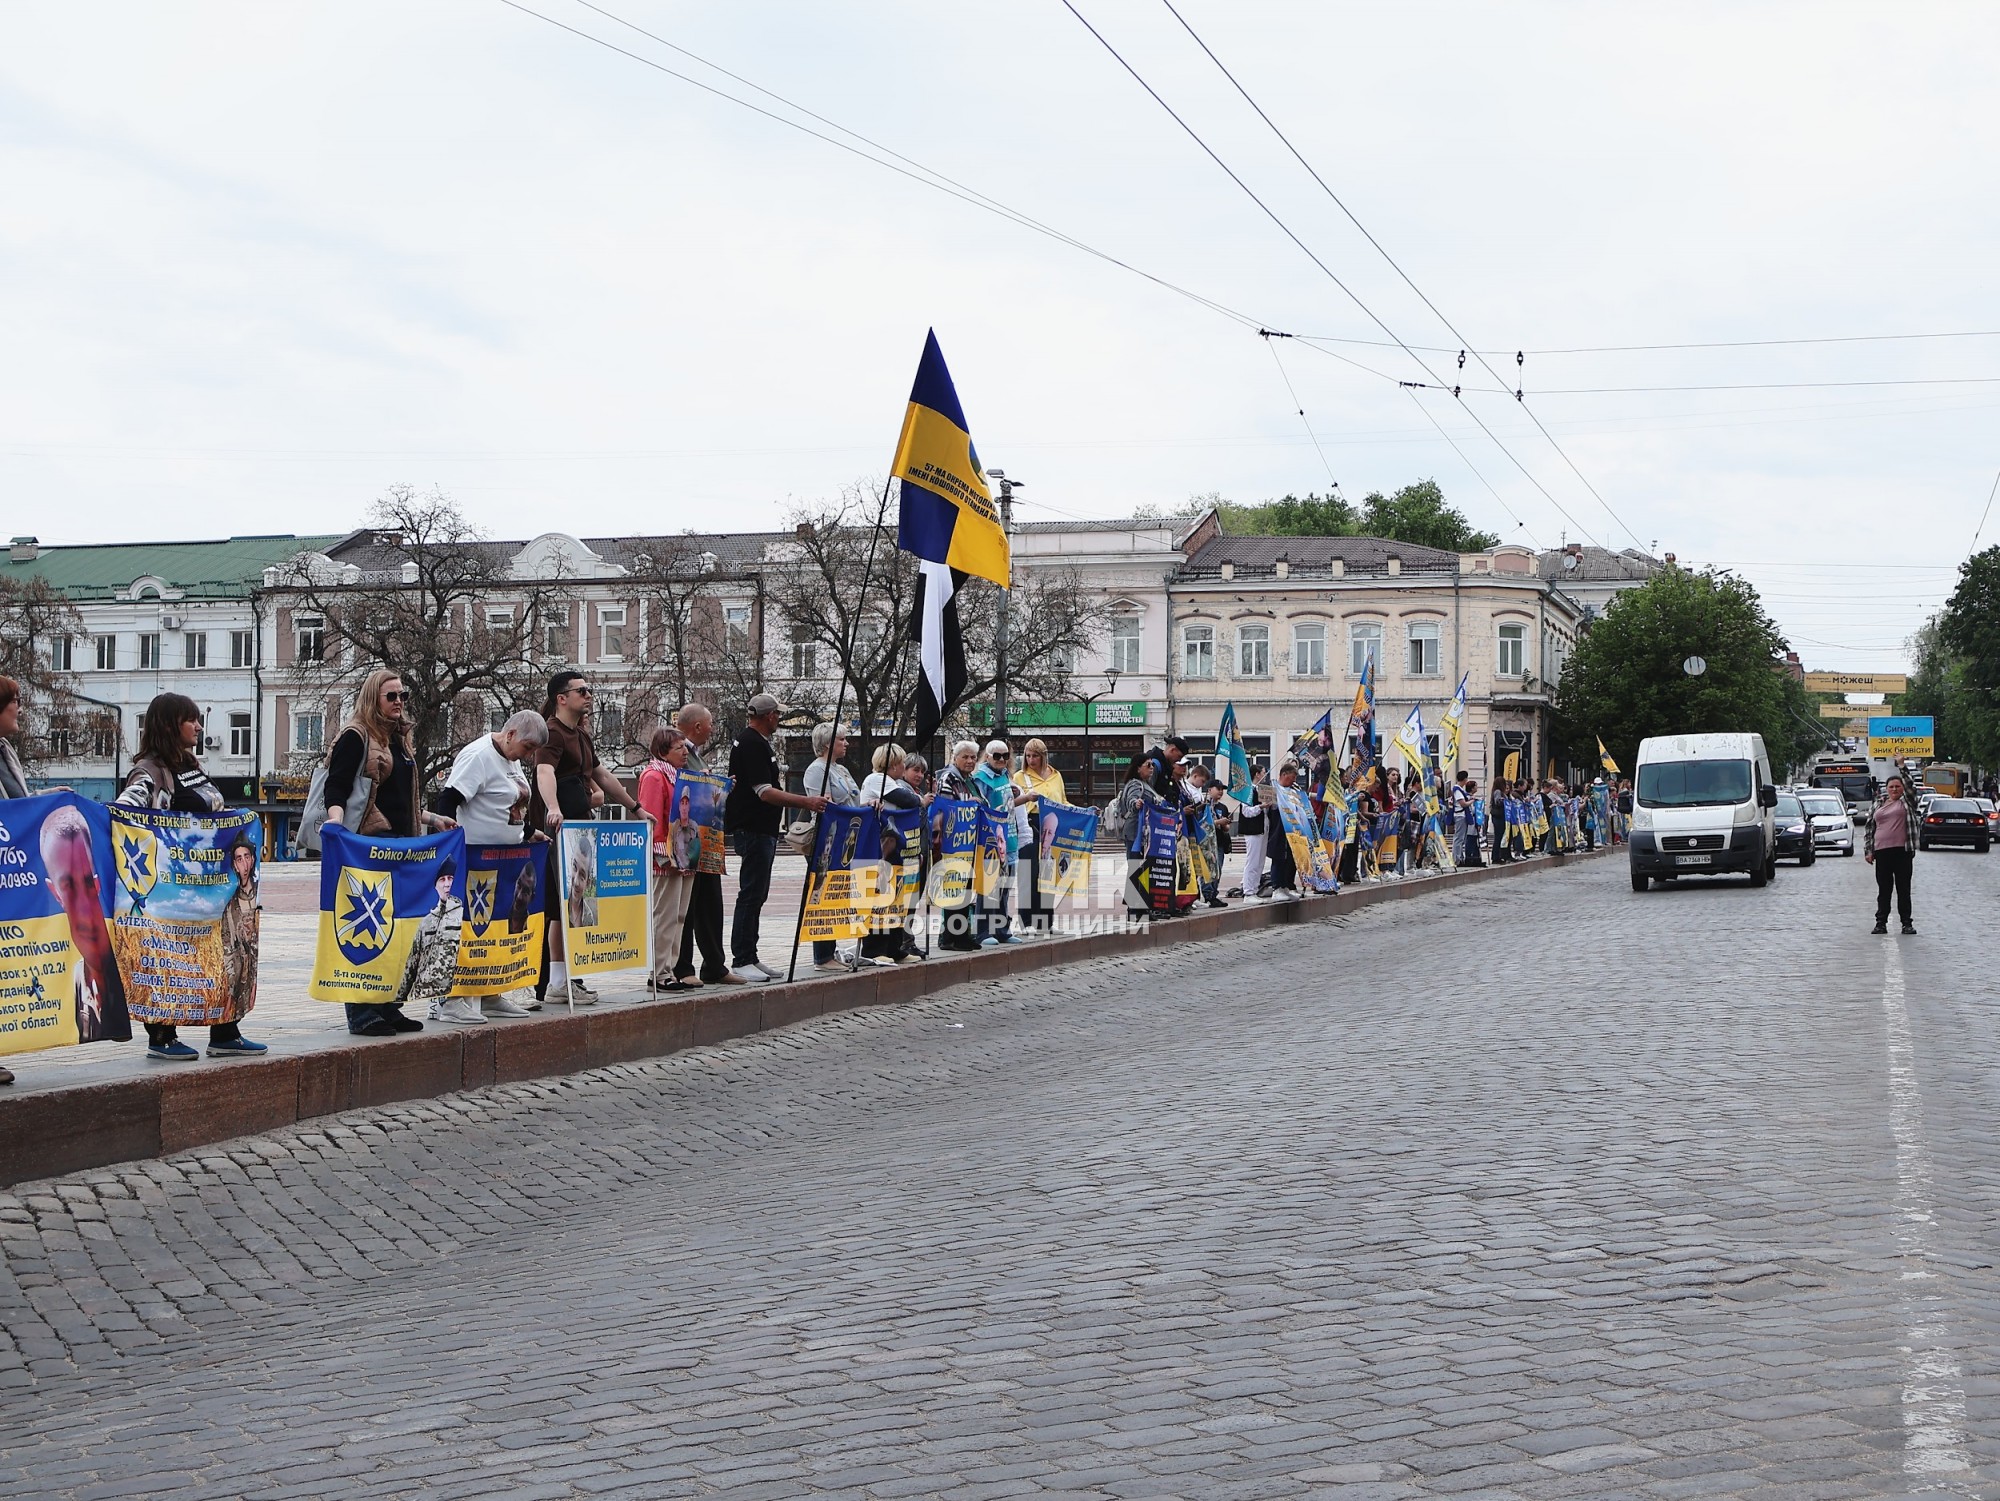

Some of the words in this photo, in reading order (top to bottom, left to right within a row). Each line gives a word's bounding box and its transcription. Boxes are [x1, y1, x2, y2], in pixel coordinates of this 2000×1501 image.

[924, 463, 946, 477] 57-МА
[946, 472, 969, 492] ОКРЕМА
[908, 466, 930, 481] ІМЕНІ
[929, 476, 964, 500] КОШОВОГО
[964, 494, 989, 517] ОТАМАНА
[1885, 724, 1917, 733] Сигнал
[1891, 737, 1907, 745] тих,
[600, 833, 609, 847] 56
[611, 832, 644, 849] ОМПБр
[170, 847, 185, 860] 56
[369, 846, 403, 861] Бойко
[404, 846, 437, 863] Андрій
[585, 931, 627, 945] Мельничук
[574, 952, 590, 966] Олег
[591, 948, 639, 964] Анатолійович
[350, 970, 383, 983] окрема
[362, 981, 394, 993] бригада
[28, 999, 62, 1014] району
[21, 1014, 58, 1030] області
